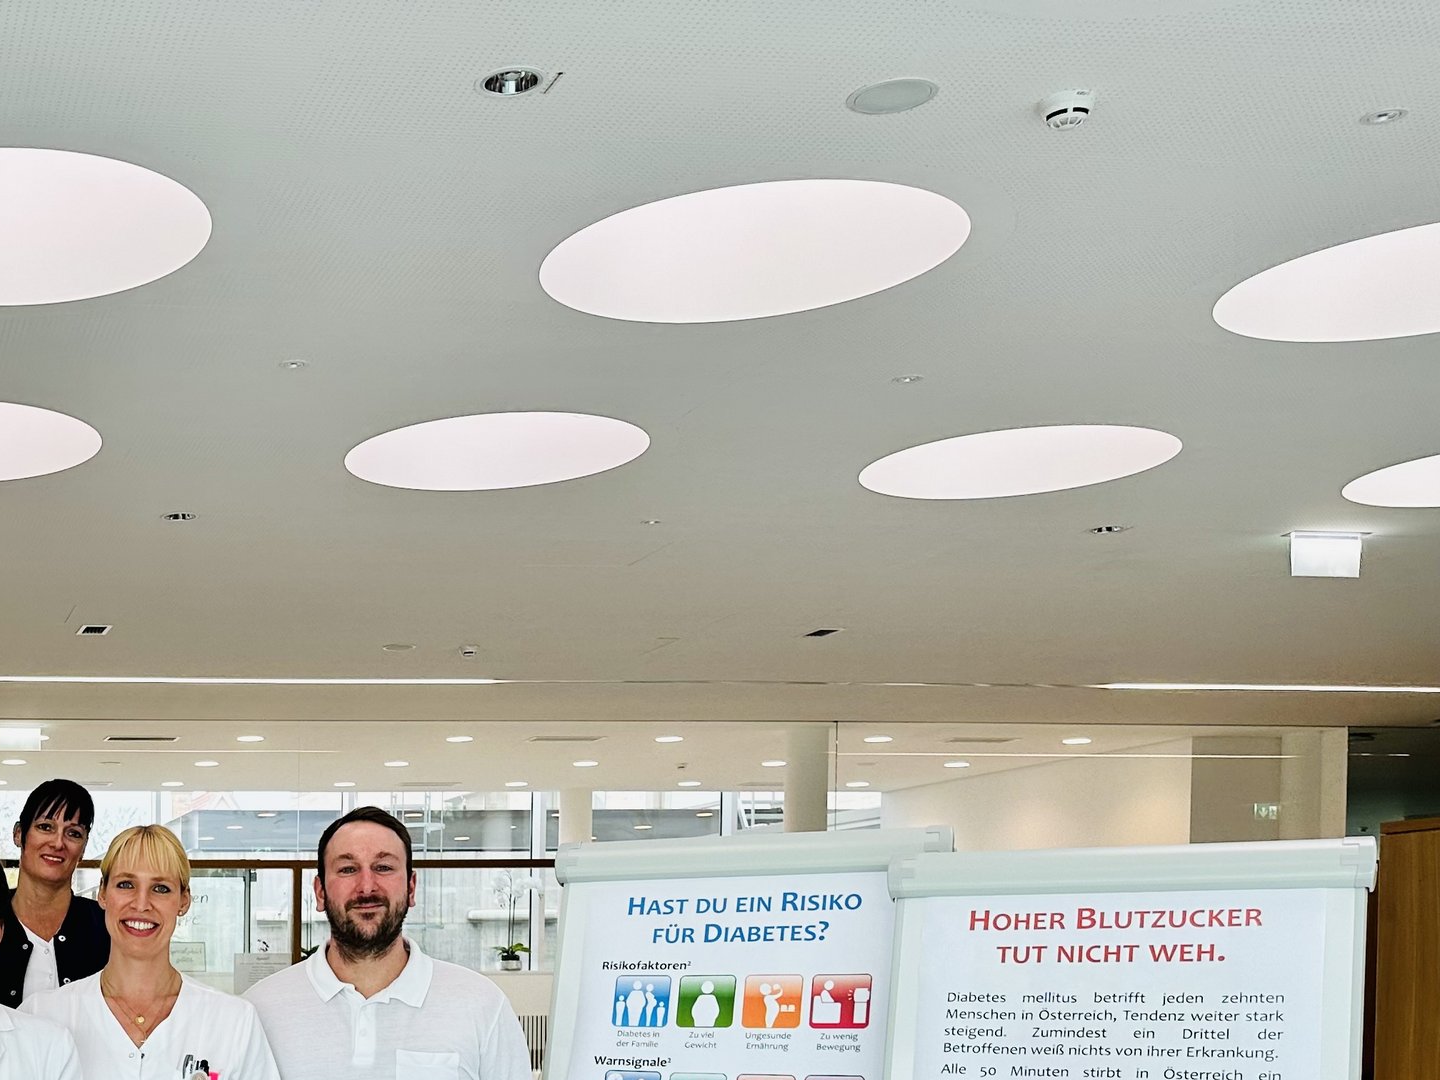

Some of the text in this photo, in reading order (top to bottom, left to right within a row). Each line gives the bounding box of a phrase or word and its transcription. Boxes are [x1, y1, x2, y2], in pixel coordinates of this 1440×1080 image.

[947, 992, 1285, 1007] Diabetes mellitus betrifft jeden zehnten
[946, 1007, 1284, 1025] Menschen in Österreich, Tendenz weiter stark
[616, 1029, 660, 1039] Diabetes in
[688, 1030, 715, 1039] Zu viel
[745, 1031, 792, 1042] Ungesunde
[820, 1032, 859, 1044] Zu wenig
[944, 1025, 1284, 1041] steigend. Zumindest ein Drittel der
[616, 1039, 659, 1049] der Familie
[684, 1040, 717, 1050] Gewicht
[746, 1041, 789, 1053] Ernährung
[816, 1042, 861, 1054] Bewegung
[943, 1042, 1279, 1062] Betroffenen weiß nichts von ihrer Erkrankung.
[941, 1063, 967, 1075] Alle
[980, 1066, 997, 1078] 50
[1010, 1065, 1069, 1078] Minuten
[1083, 1066, 1122, 1079] stirbt
[1136, 1067, 1149, 1079] in
